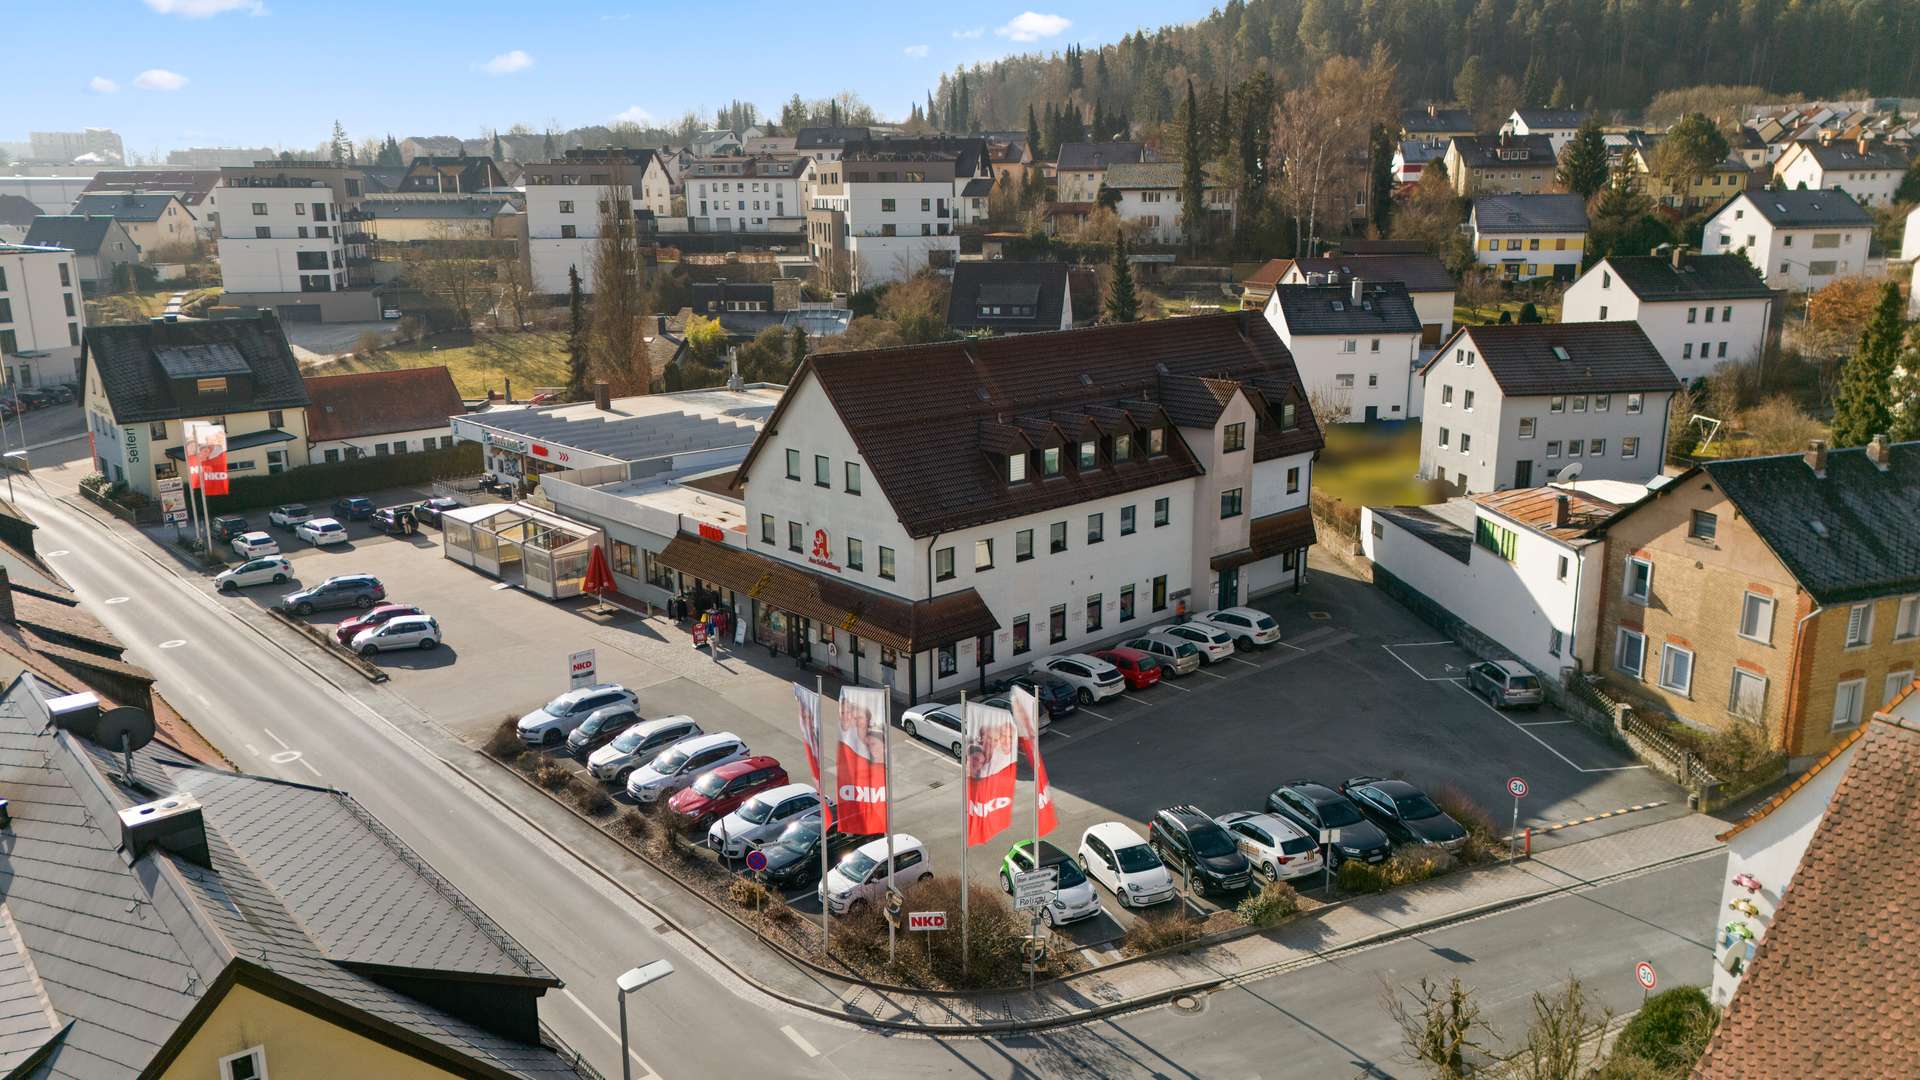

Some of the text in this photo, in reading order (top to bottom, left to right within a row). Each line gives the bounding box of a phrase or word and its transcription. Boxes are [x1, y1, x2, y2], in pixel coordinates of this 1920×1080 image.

[124, 427, 140, 464] Seifert
[204, 472, 228, 481] NKD
[573, 661, 593, 671] NKD
[1512, 782, 1524, 793] 30
[968, 796, 1011, 818] NKD
[911, 915, 945, 928] NKD
[1640, 968, 1652, 983] 30
